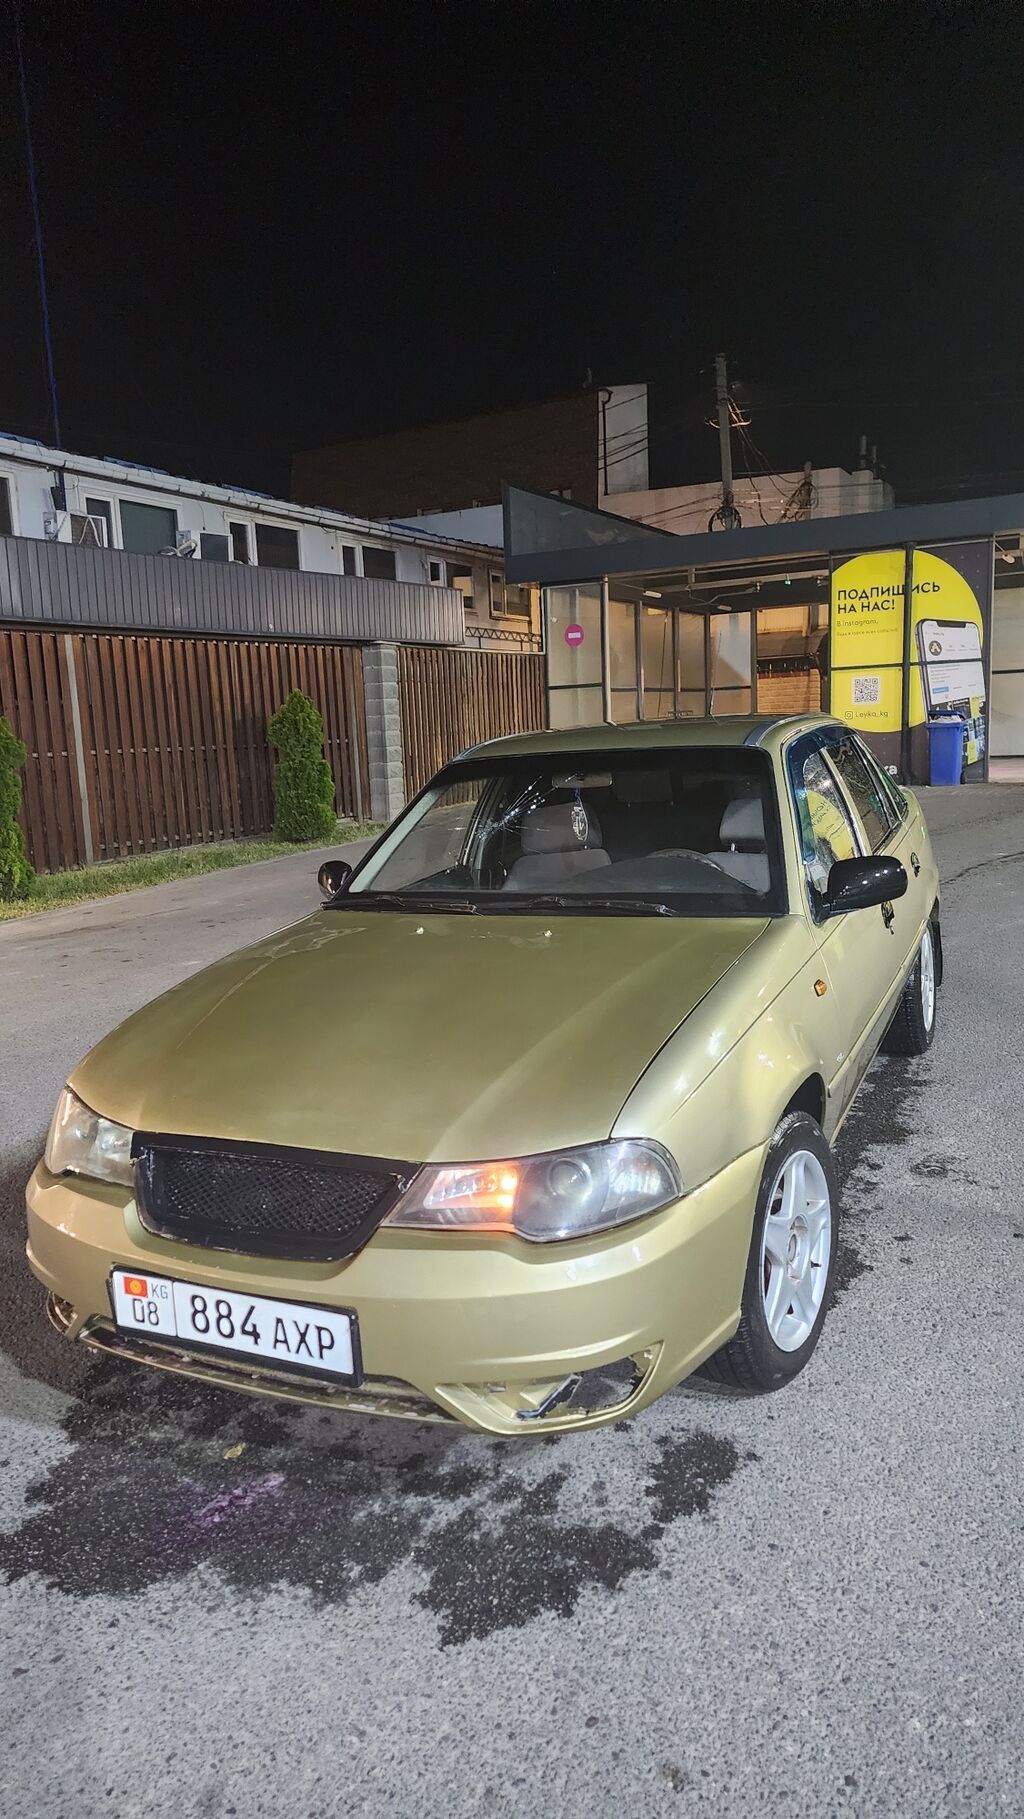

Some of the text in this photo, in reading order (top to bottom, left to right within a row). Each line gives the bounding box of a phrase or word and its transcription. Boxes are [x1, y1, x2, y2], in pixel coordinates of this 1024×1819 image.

[837, 581, 941, 601] ПОДПИШИСЬ
[837, 599, 895, 615] НА НАС!
[855, 710, 889, 719] Leyka_kg
[150, 1282, 169, 1300] KG
[132, 1298, 160, 1327] 08
[190, 1293, 336, 1361] 884 AXP
